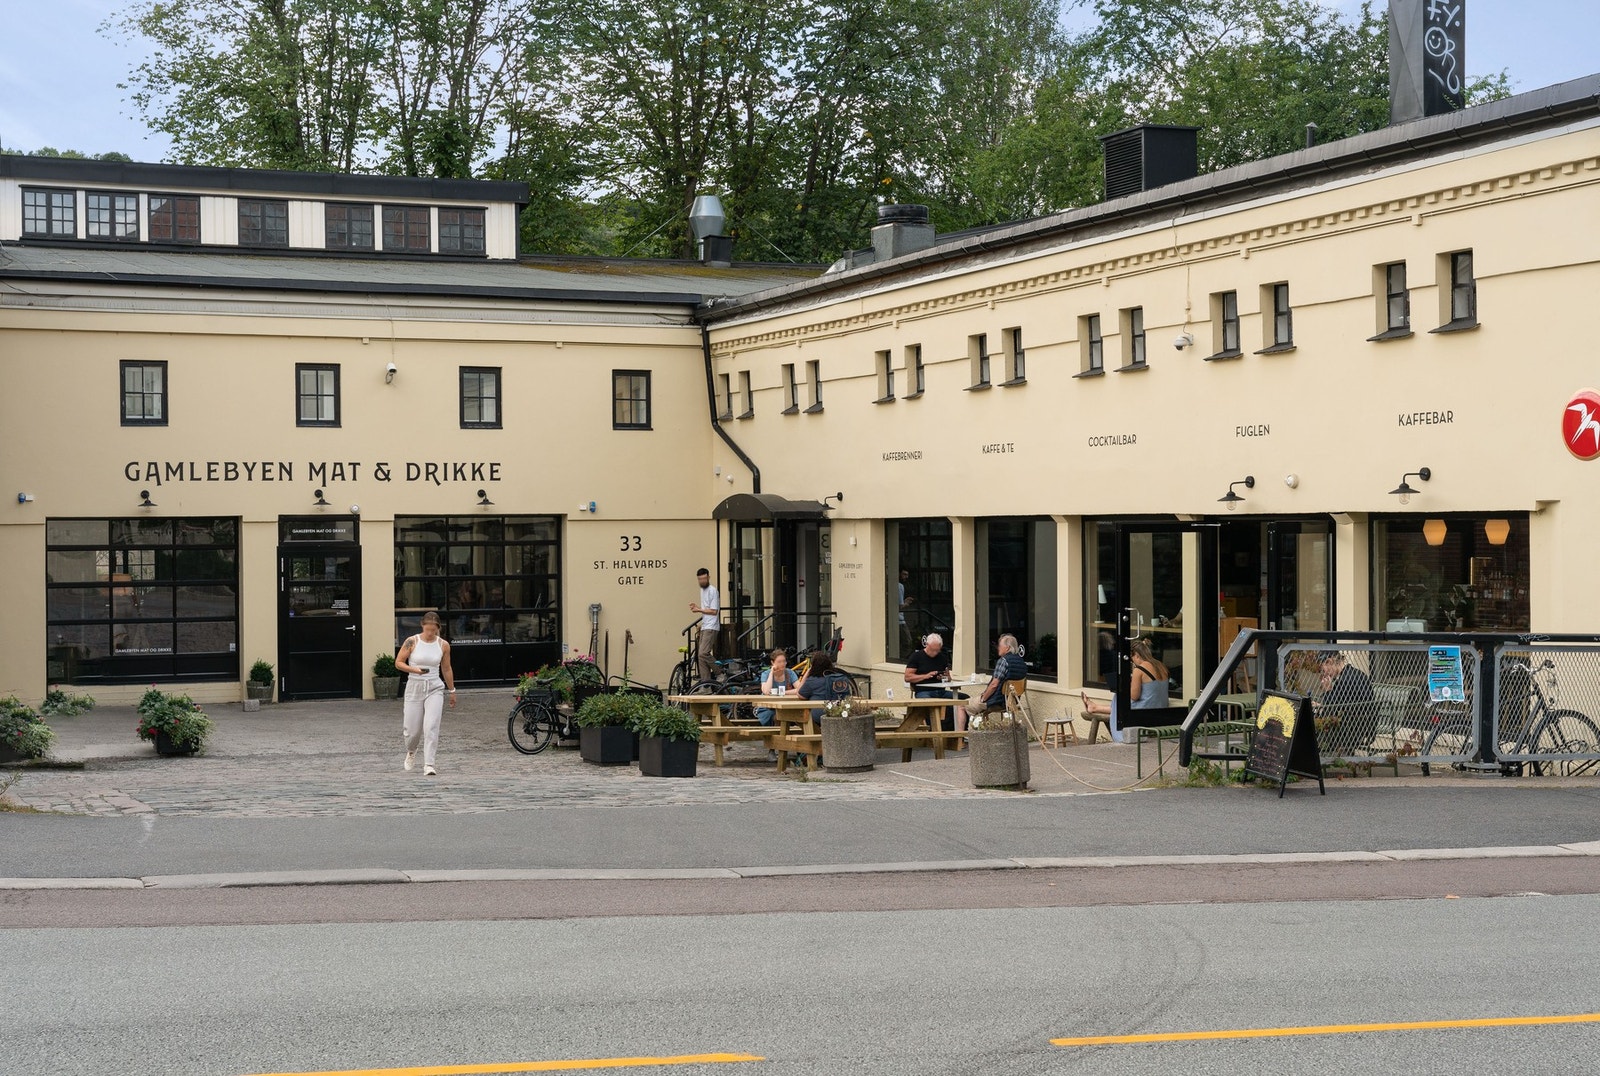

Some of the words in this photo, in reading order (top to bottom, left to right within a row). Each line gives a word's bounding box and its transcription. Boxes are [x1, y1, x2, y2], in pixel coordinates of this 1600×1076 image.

[1398, 410, 1454, 426] KAFFEBAR
[1235, 424, 1270, 437] FUGLEN
[1088, 434, 1137, 447] COCKTAILBAR
[982, 443, 1000, 454] KAFFE
[1001, 443, 1006, 453] &
[1007, 442, 1015, 453] TE
[882, 450, 923, 462] KAFFEBRENNERI
[124, 461, 294, 486] GAMLEBYEN
[308, 462, 361, 487] MAT
[374, 462, 391, 482] &
[405, 462, 502, 486] DRIKKE
[620, 535, 642, 551] 33
[593, 560, 608, 570] ST.
[613, 559, 668, 569] HALVARDS
[618, 576, 644, 585] GATE
